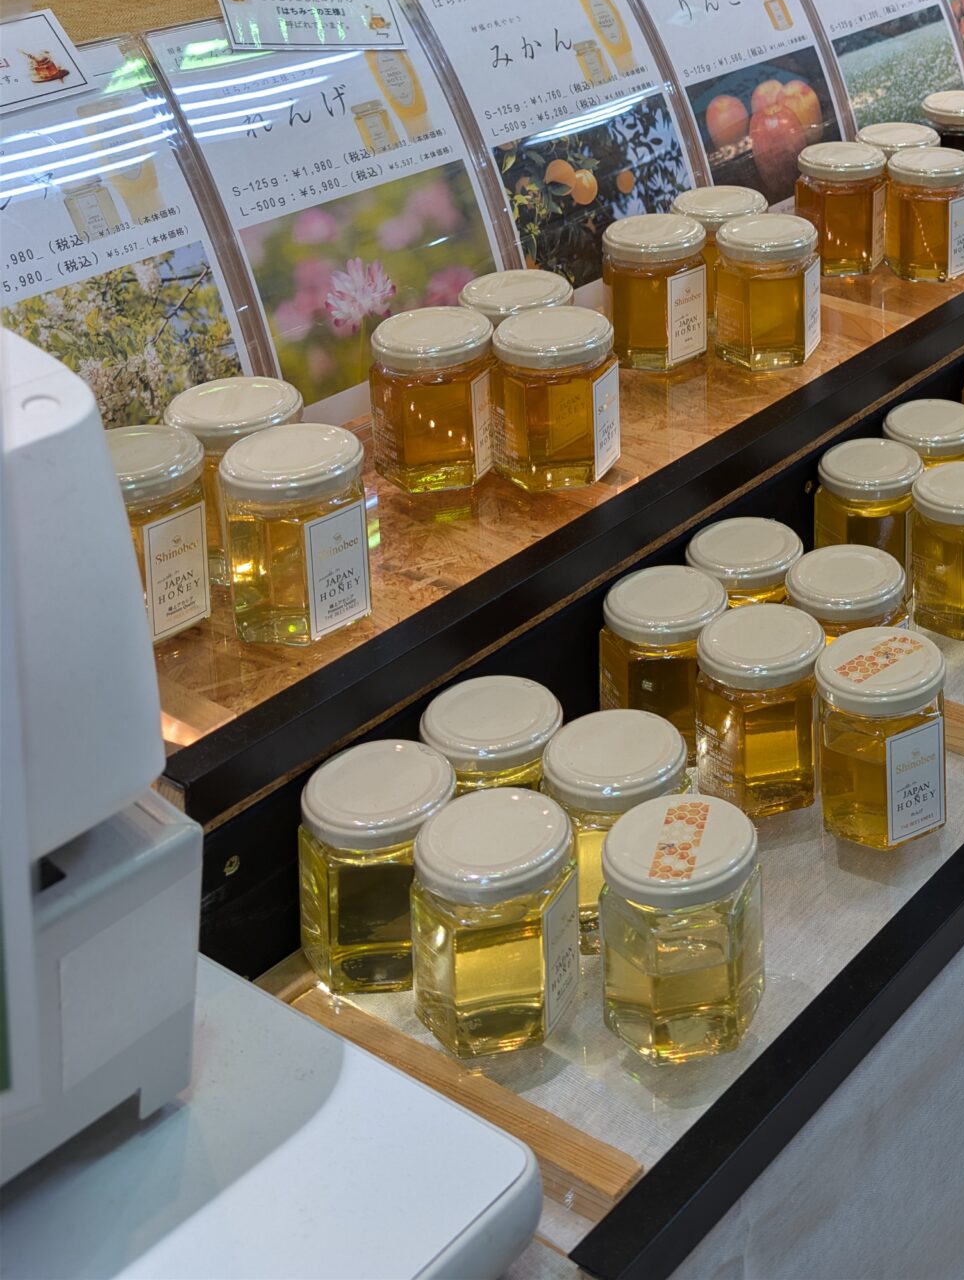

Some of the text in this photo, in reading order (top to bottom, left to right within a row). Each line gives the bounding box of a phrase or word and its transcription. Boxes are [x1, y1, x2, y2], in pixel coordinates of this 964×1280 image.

[490, 28, 572, 69] みかん
[242, 83, 347, 139] れんげ
[49, 231, 91, 255] (税込)
[137, 205, 181, 226] (本体価格)
[57, 251, 99, 276] (税込)
[147, 225, 190, 246] (本体価格)
[164, 570, 193, 590] JAPAN
[320, 576, 360, 602] HONEY
[326, 568, 354, 588] JAPAN
[158, 579, 199, 604] HONEY
[897, 789, 936, 812] HONEY
[903, 782, 930, 799] JAPAN
